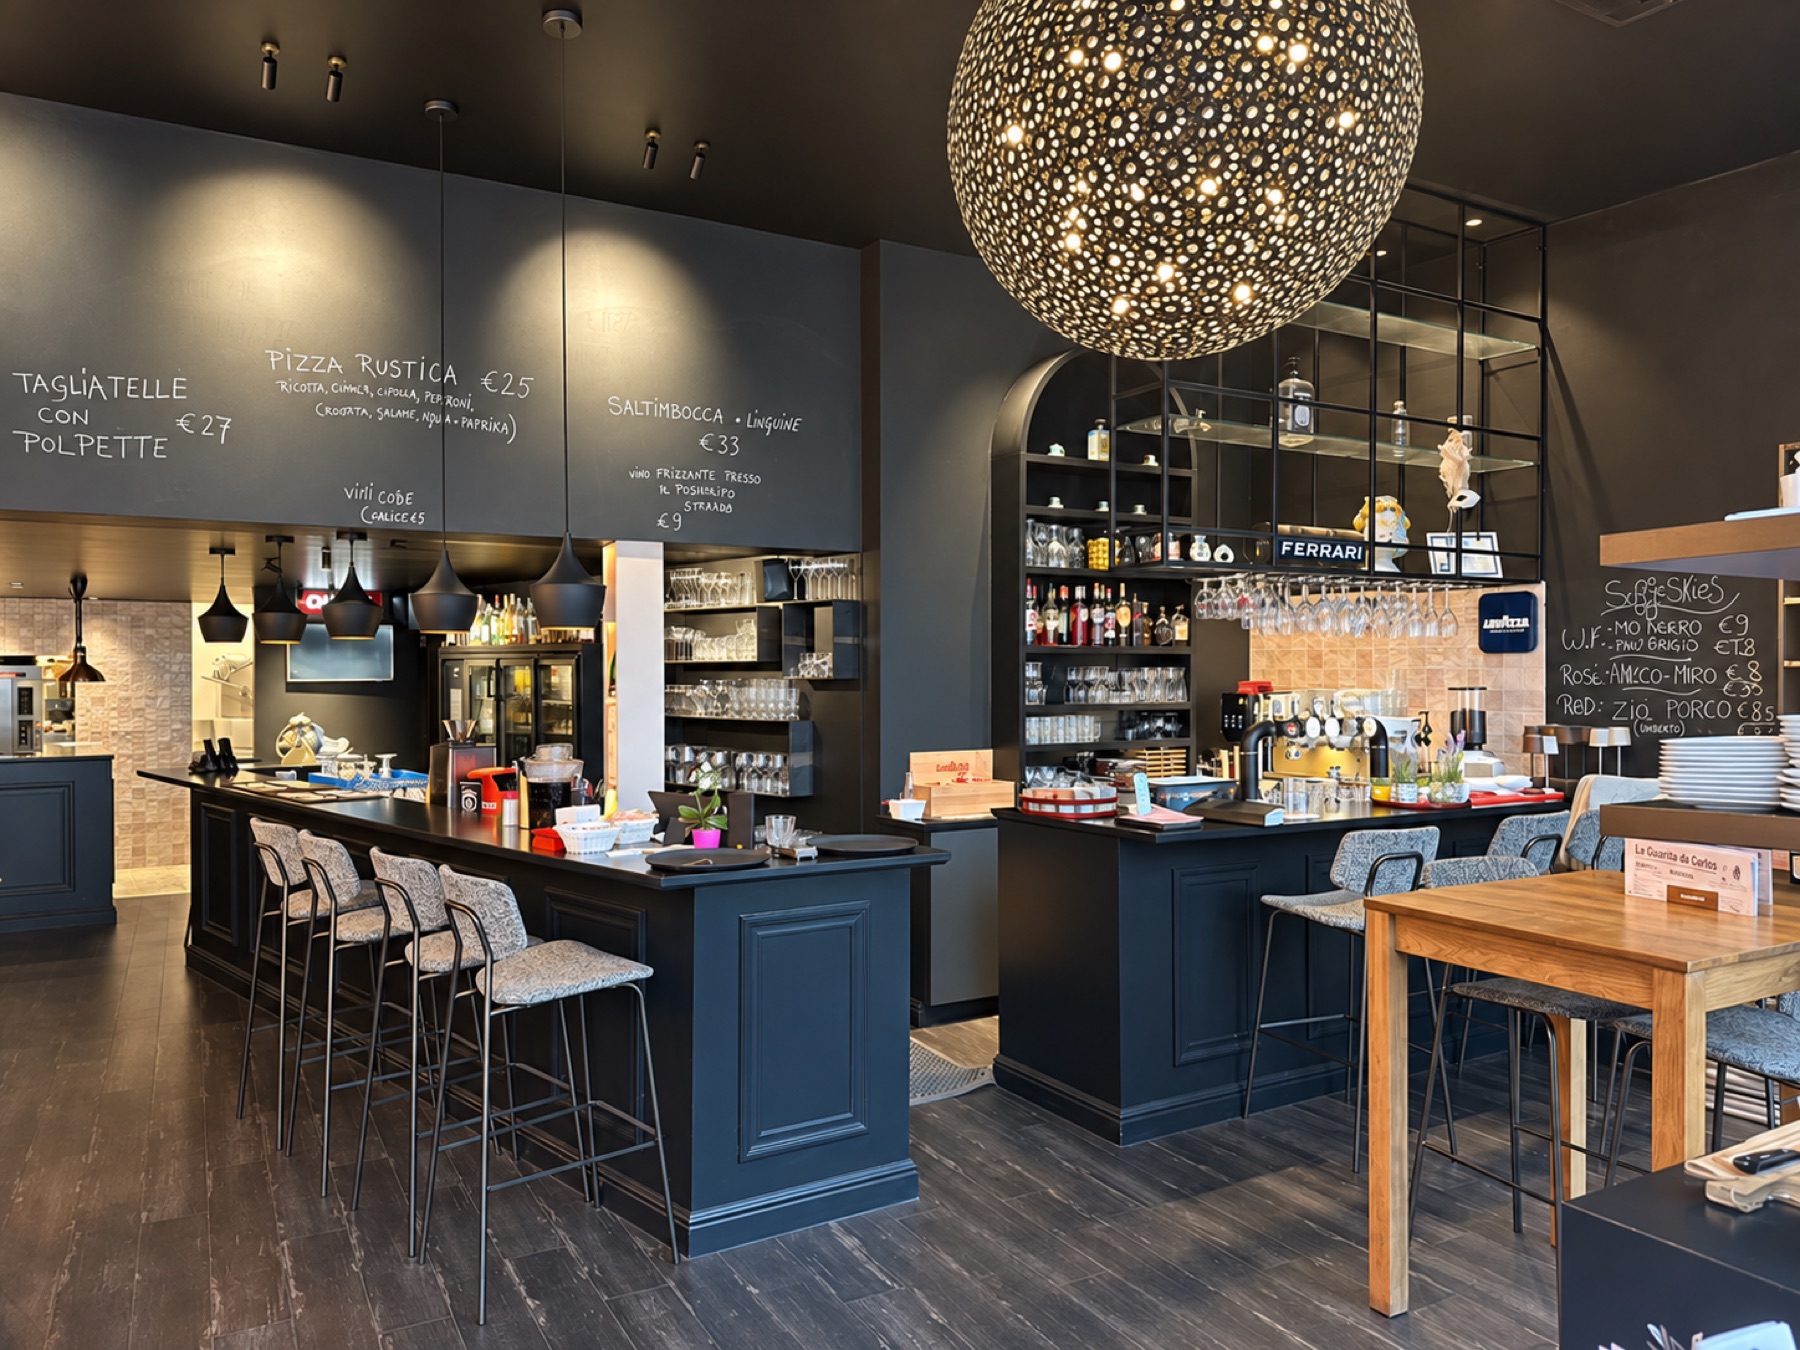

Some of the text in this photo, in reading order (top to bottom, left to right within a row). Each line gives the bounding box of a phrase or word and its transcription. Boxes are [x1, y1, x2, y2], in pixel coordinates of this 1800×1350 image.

[355, 354, 457, 385] RUSTICA
[12, 367, 188, 402] TAGLIATELLE
[480, 370, 535, 399] €25
[37, 407, 89, 425] CON
[175, 412, 232, 445] €27
[607, 396, 803, 436] SALTIMBOCCA LINGUINE
[12, 430, 169, 459] POLPETTE
[699, 433, 740, 456] €33
[656, 512, 682, 531] €9
[1281, 540, 1363, 561] FERRARI
[1666, 699, 1732, 721] PORCO
